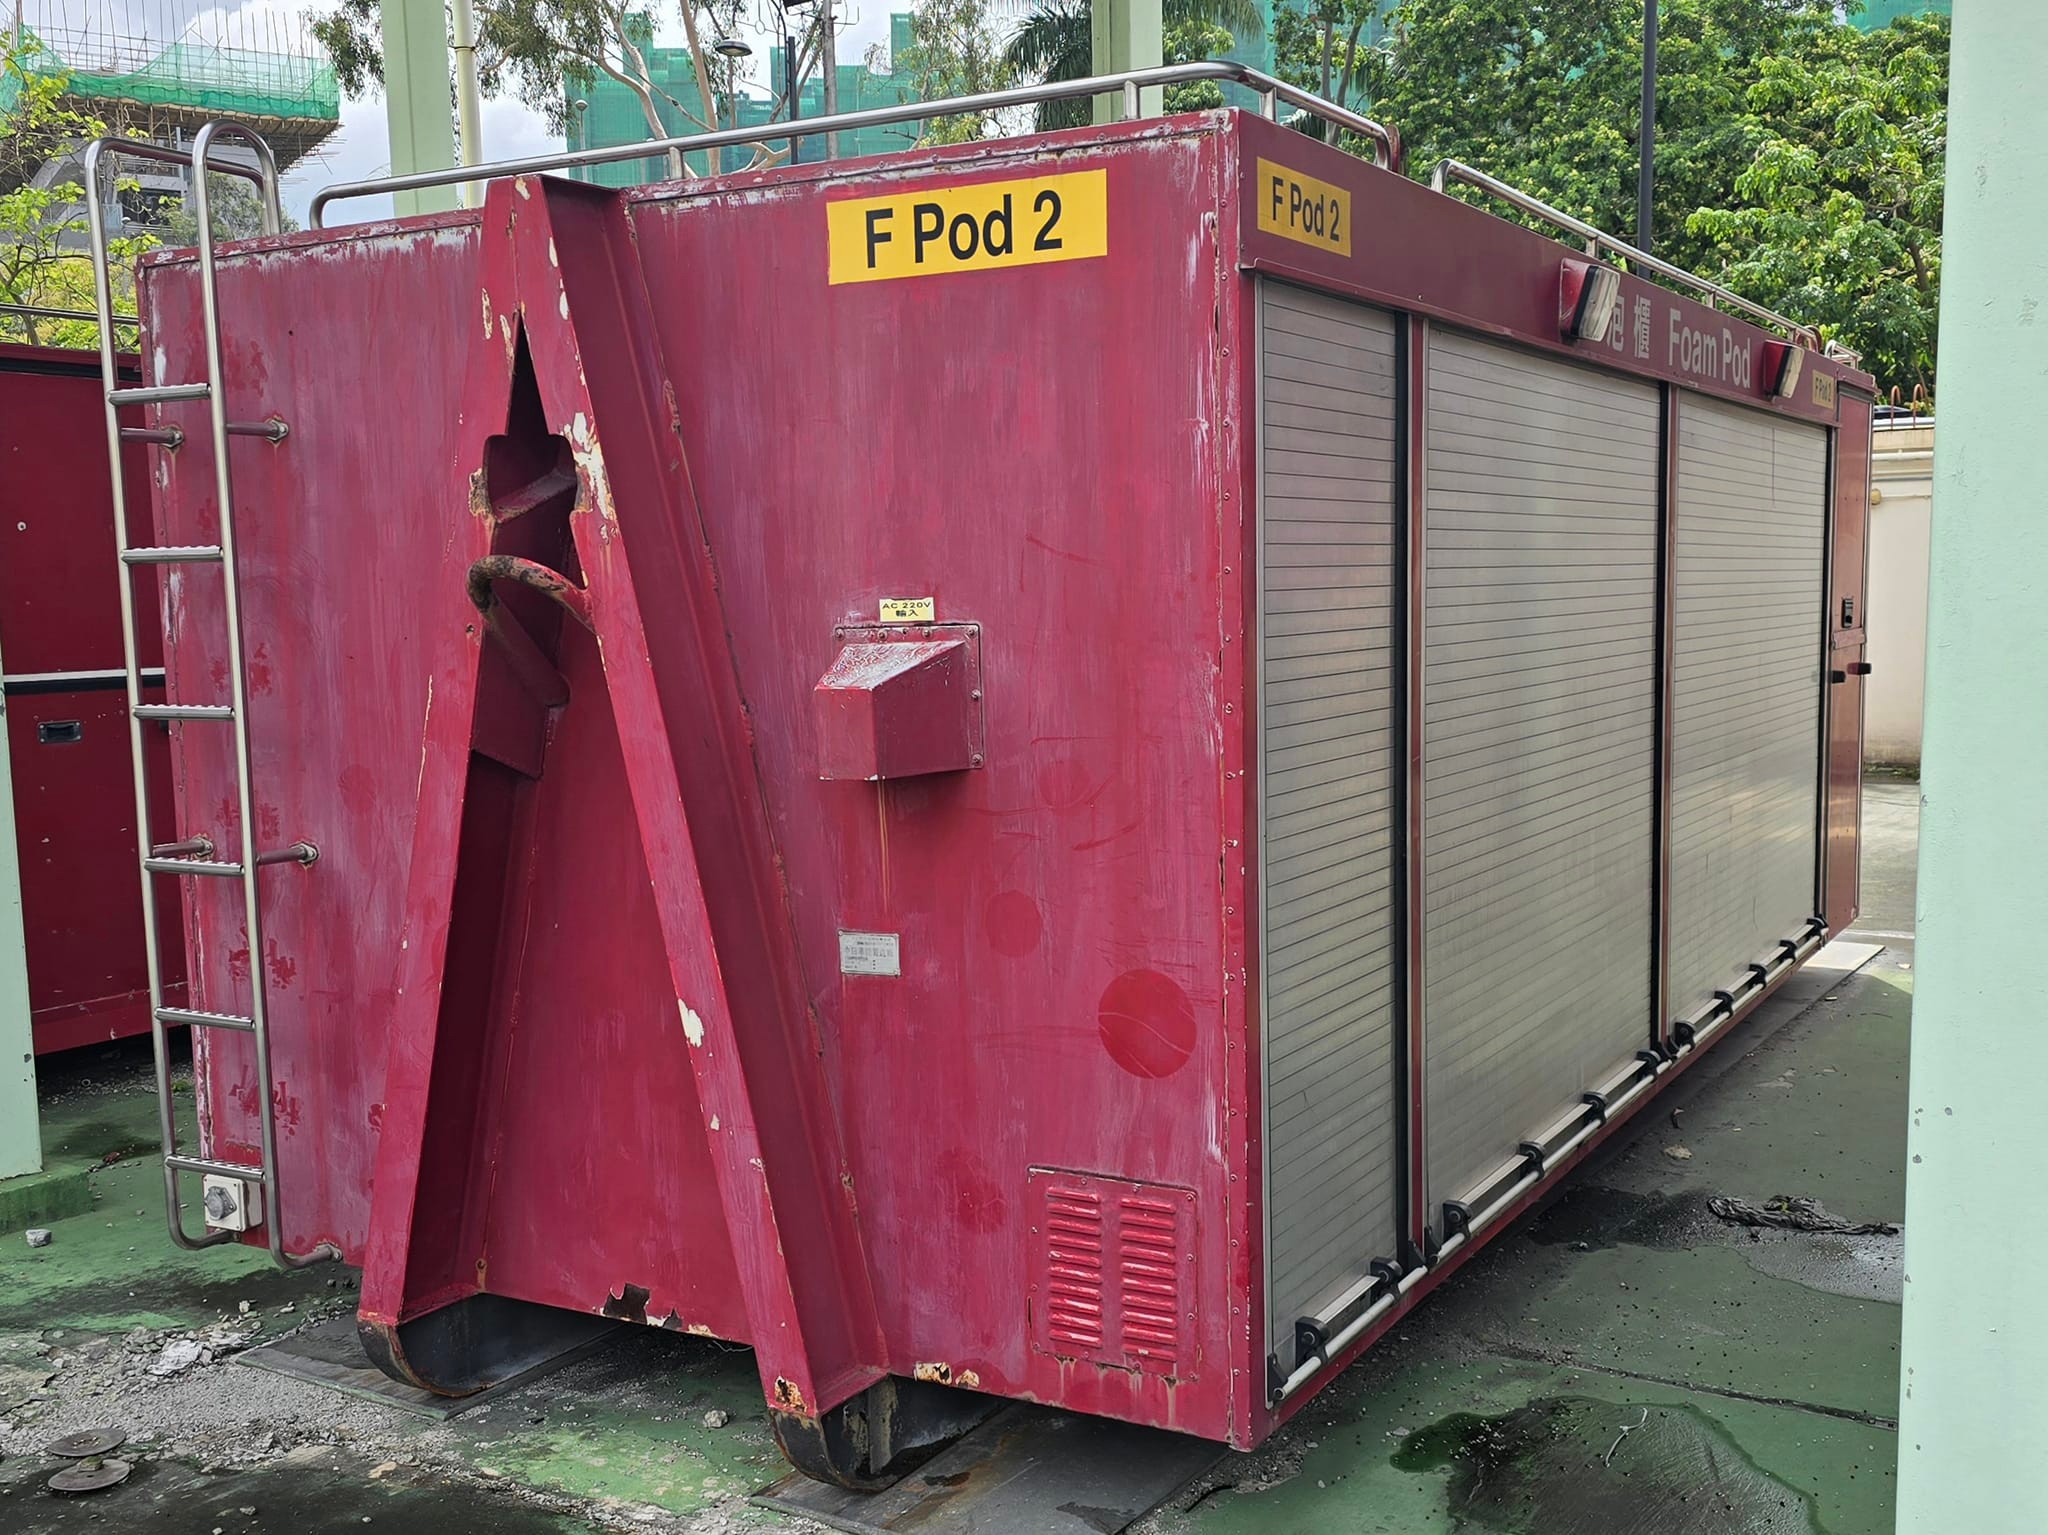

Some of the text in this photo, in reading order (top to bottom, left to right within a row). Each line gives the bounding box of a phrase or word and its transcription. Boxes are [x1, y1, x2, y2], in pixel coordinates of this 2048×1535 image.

[865, 189, 1063, 269] F Pod 2
[1272, 175, 1340, 242] F Pod 2
[1668, 307, 1751, 389] Foam Pod
[902, 601, 931, 609] 220V
